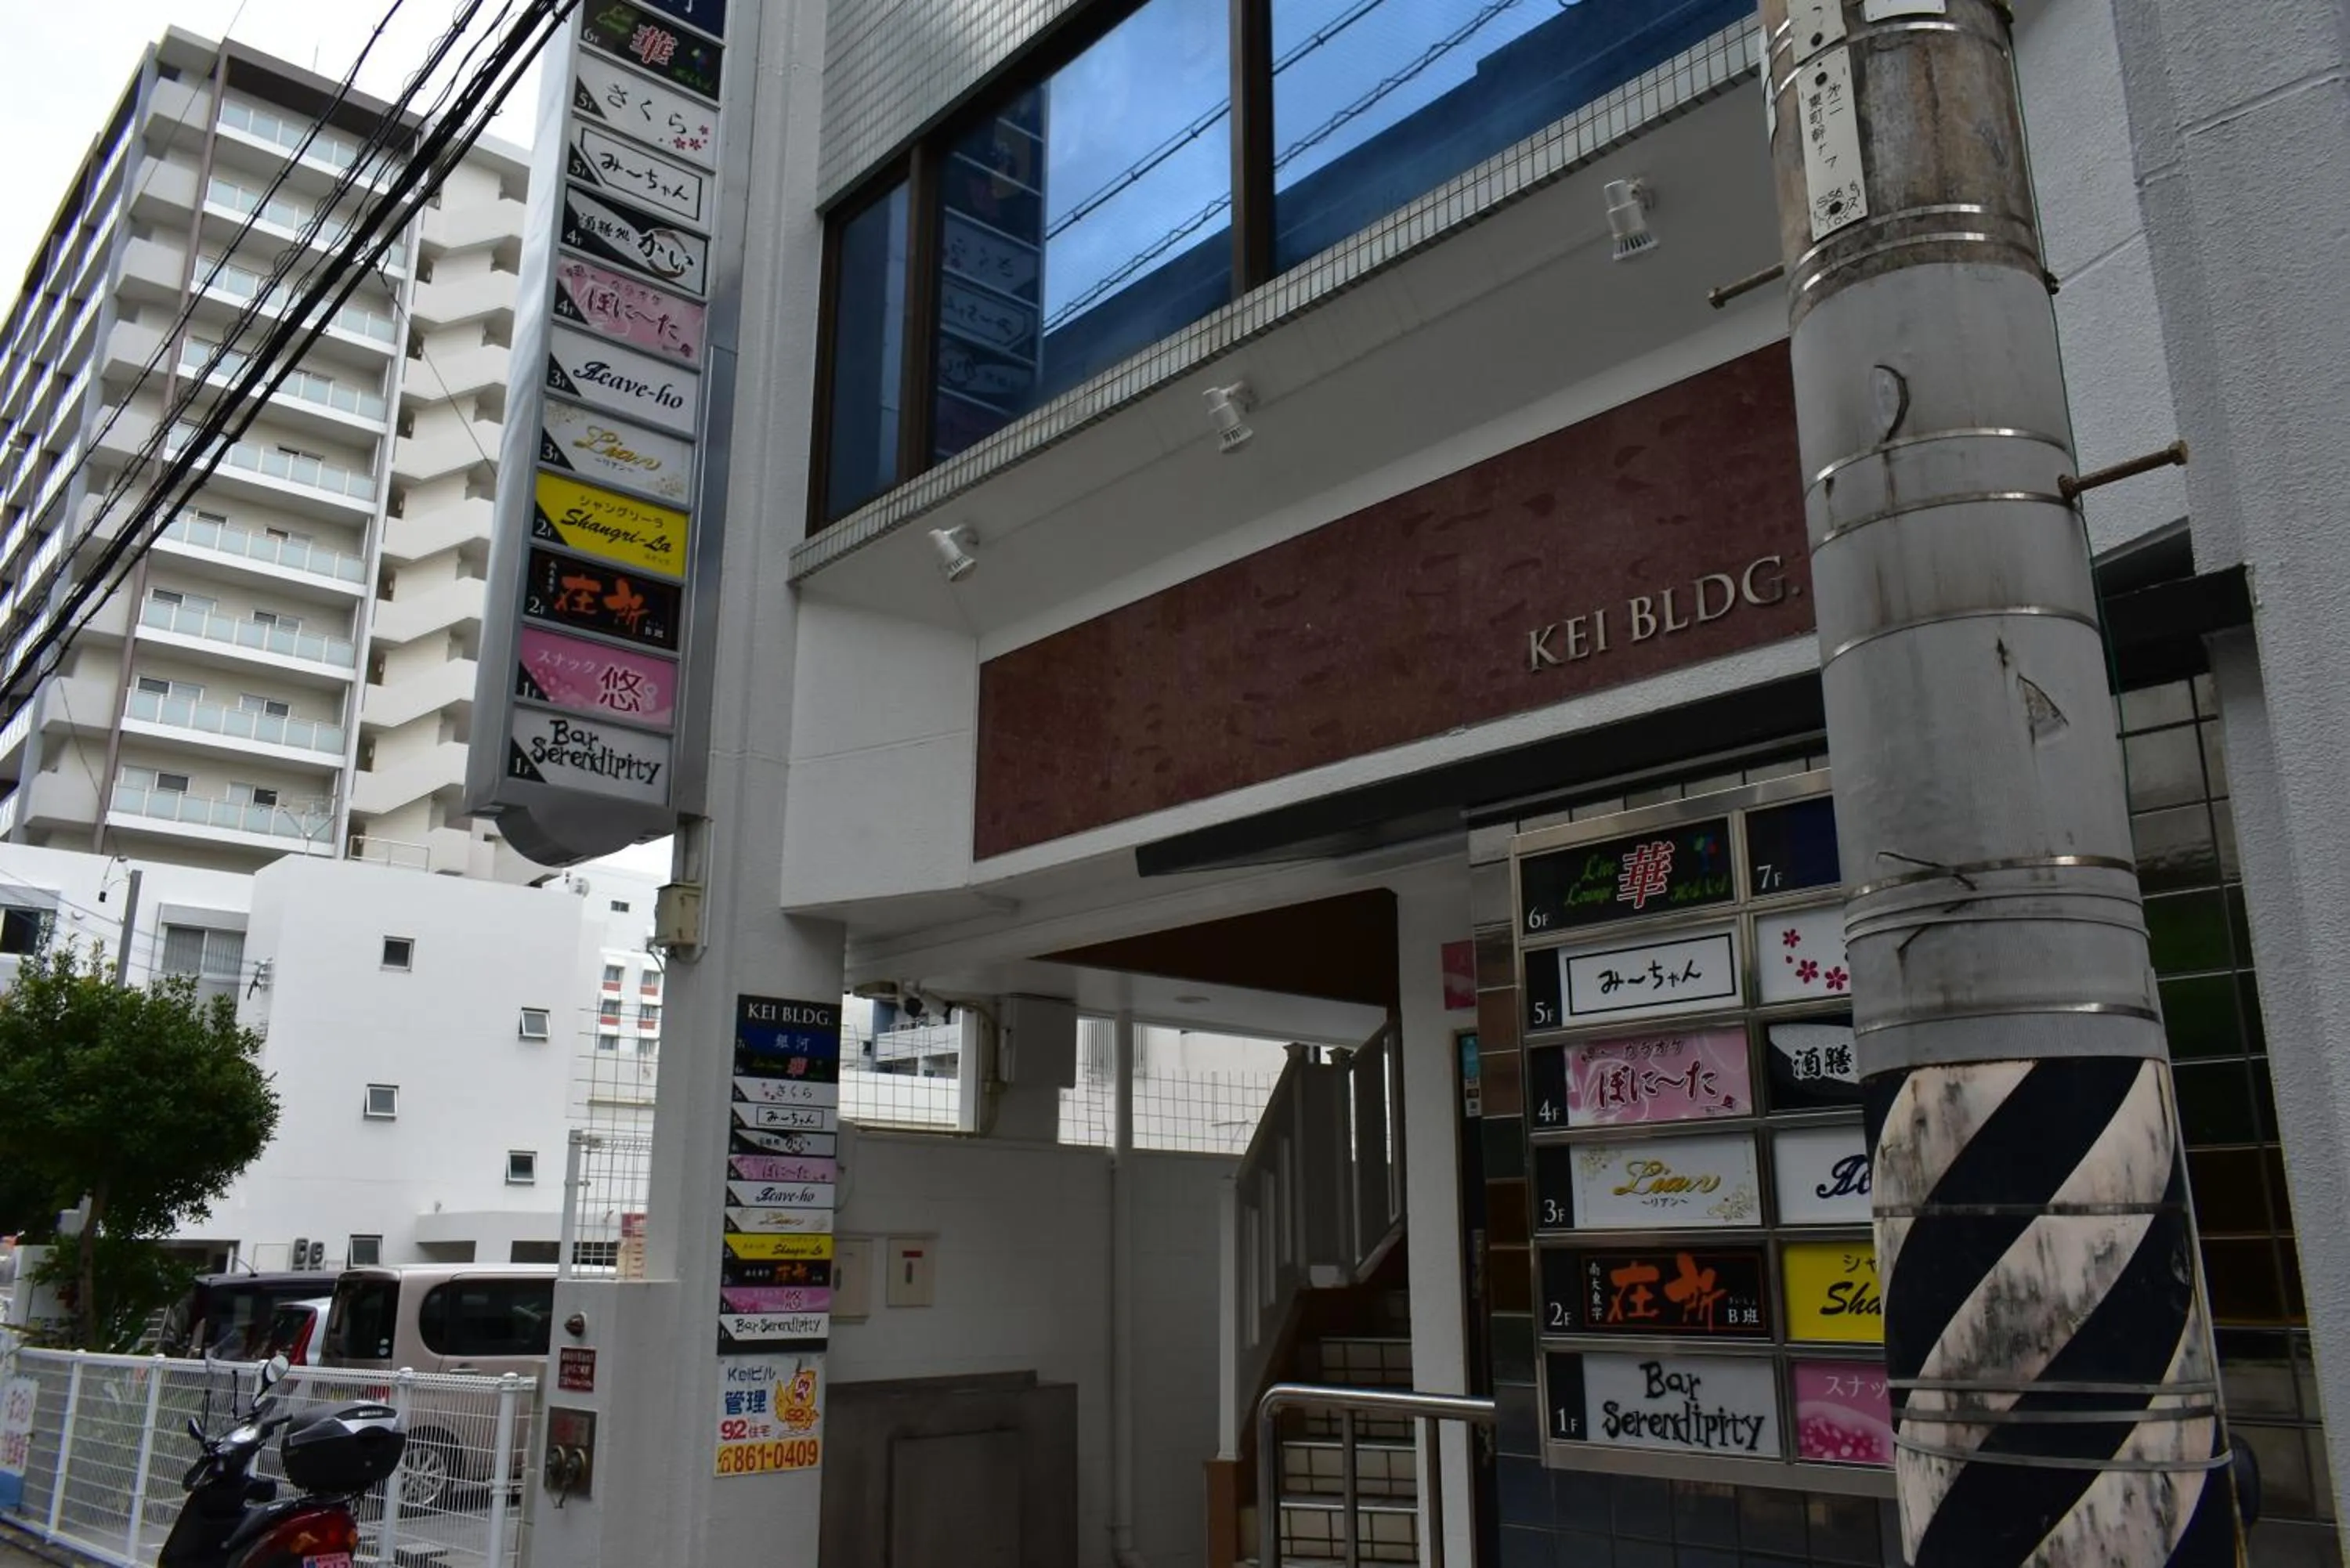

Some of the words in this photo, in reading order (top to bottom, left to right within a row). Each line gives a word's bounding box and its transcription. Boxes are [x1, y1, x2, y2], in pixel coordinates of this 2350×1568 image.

[608, 84, 687, 135] さくら
[560, 508, 672, 552] Shangri-La
[1528, 609, 1611, 672] KEI
[1628, 555, 1802, 643] BLDG.
[537, 649, 597, 674] スナック
[600, 667, 642, 712] 悠
[550, 719, 600, 751] Bar
[530, 736, 661, 784] Serendipity
[1617, 840, 1675, 909] 華
[1757, 864, 1783, 890] 7F
[1528, 905, 1549, 929] 6F
[1597, 959, 1701, 995] みーちゃん
[747, 1003, 776, 1021] KEI
[1534, 1001, 1554, 1024] 5F
[775, 1034, 811, 1053] 銀河
[1538, 1100, 1561, 1122] 4F
[1544, 1199, 1565, 1224] 3F
[736, 1318, 758, 1333] Bar
[1550, 1302, 1571, 1327] 2F
[1640, 1360, 1701, 1401] Bar
[725, 1389, 766, 1415] 管理
[1557, 1407, 1579, 1433] 1F
[1602, 1400, 1765, 1451] Serendipity
[734, 1440, 818, 1472] 861-0409
